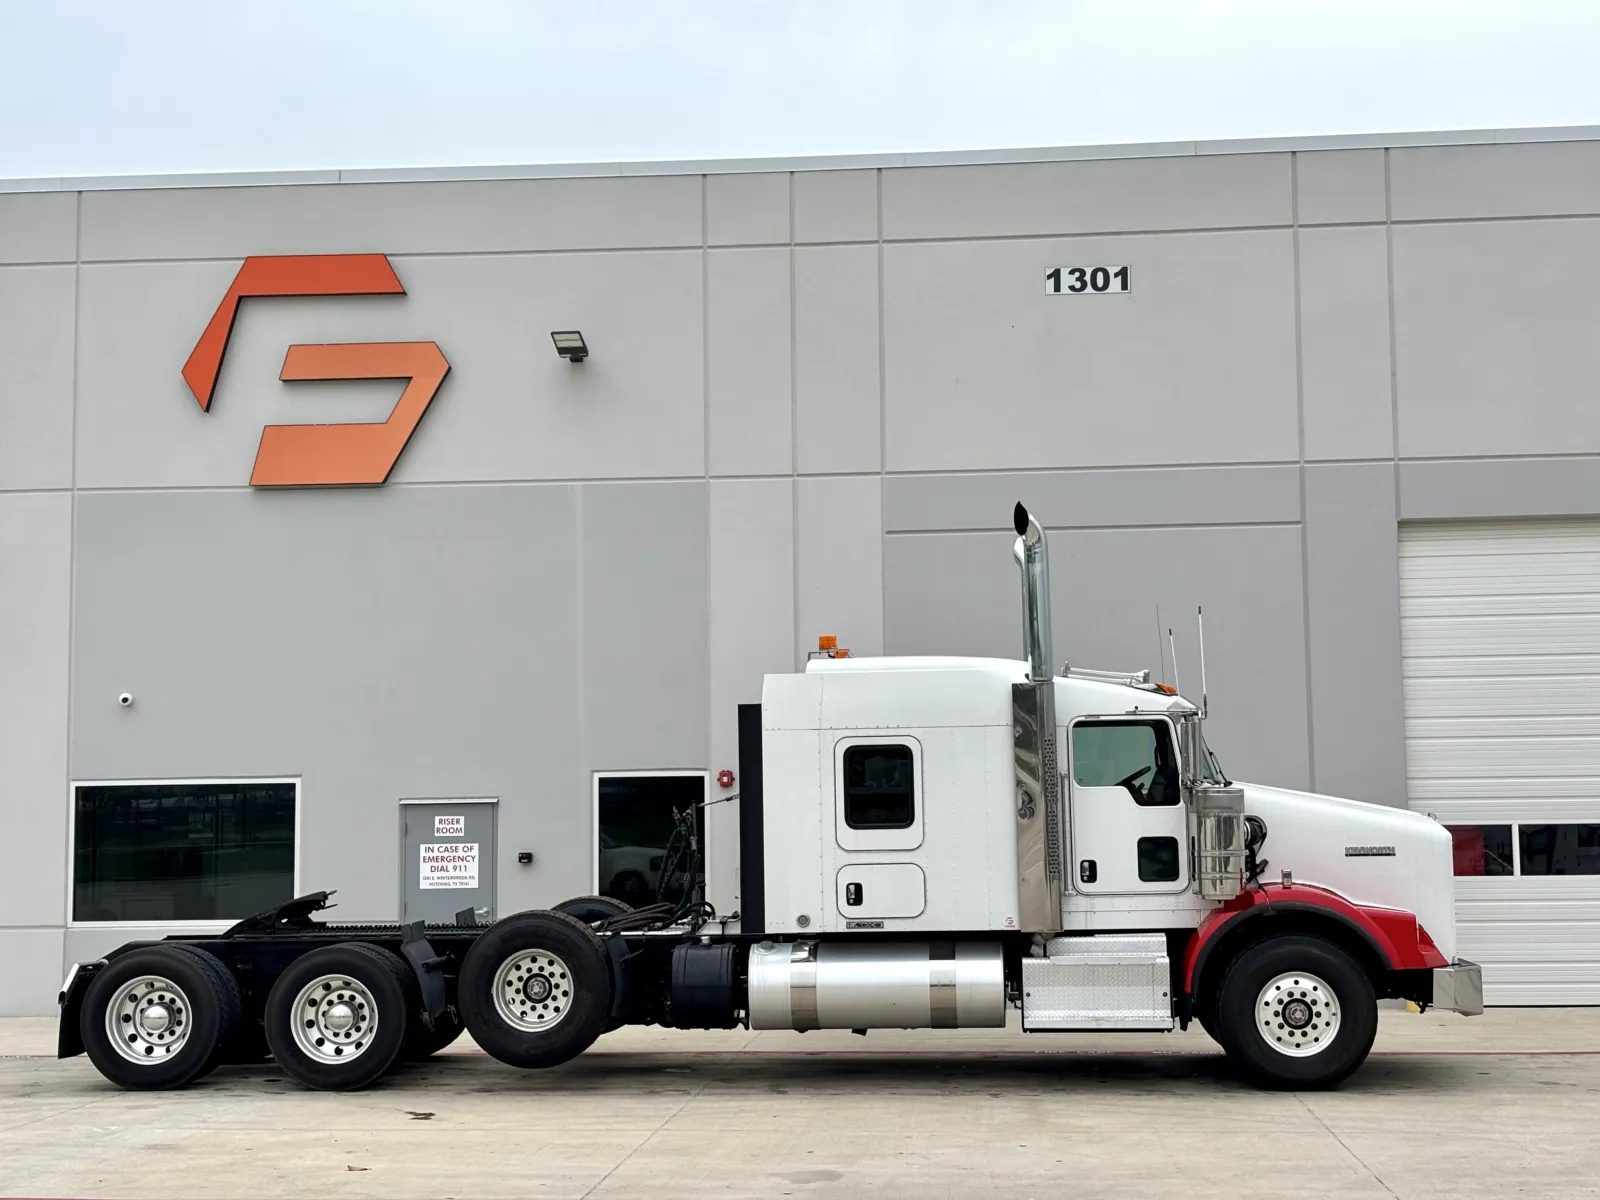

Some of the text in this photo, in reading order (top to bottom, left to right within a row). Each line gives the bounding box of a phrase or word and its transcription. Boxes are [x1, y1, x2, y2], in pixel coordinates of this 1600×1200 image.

[1046, 266, 1129, 293] 1301
[438, 818, 461, 826] RISER
[437, 845, 460, 853] CASE
[462, 845, 475, 853] OF
[422, 855, 476, 863] EMERGENCY
[430, 865, 468, 873] DIAL 911
